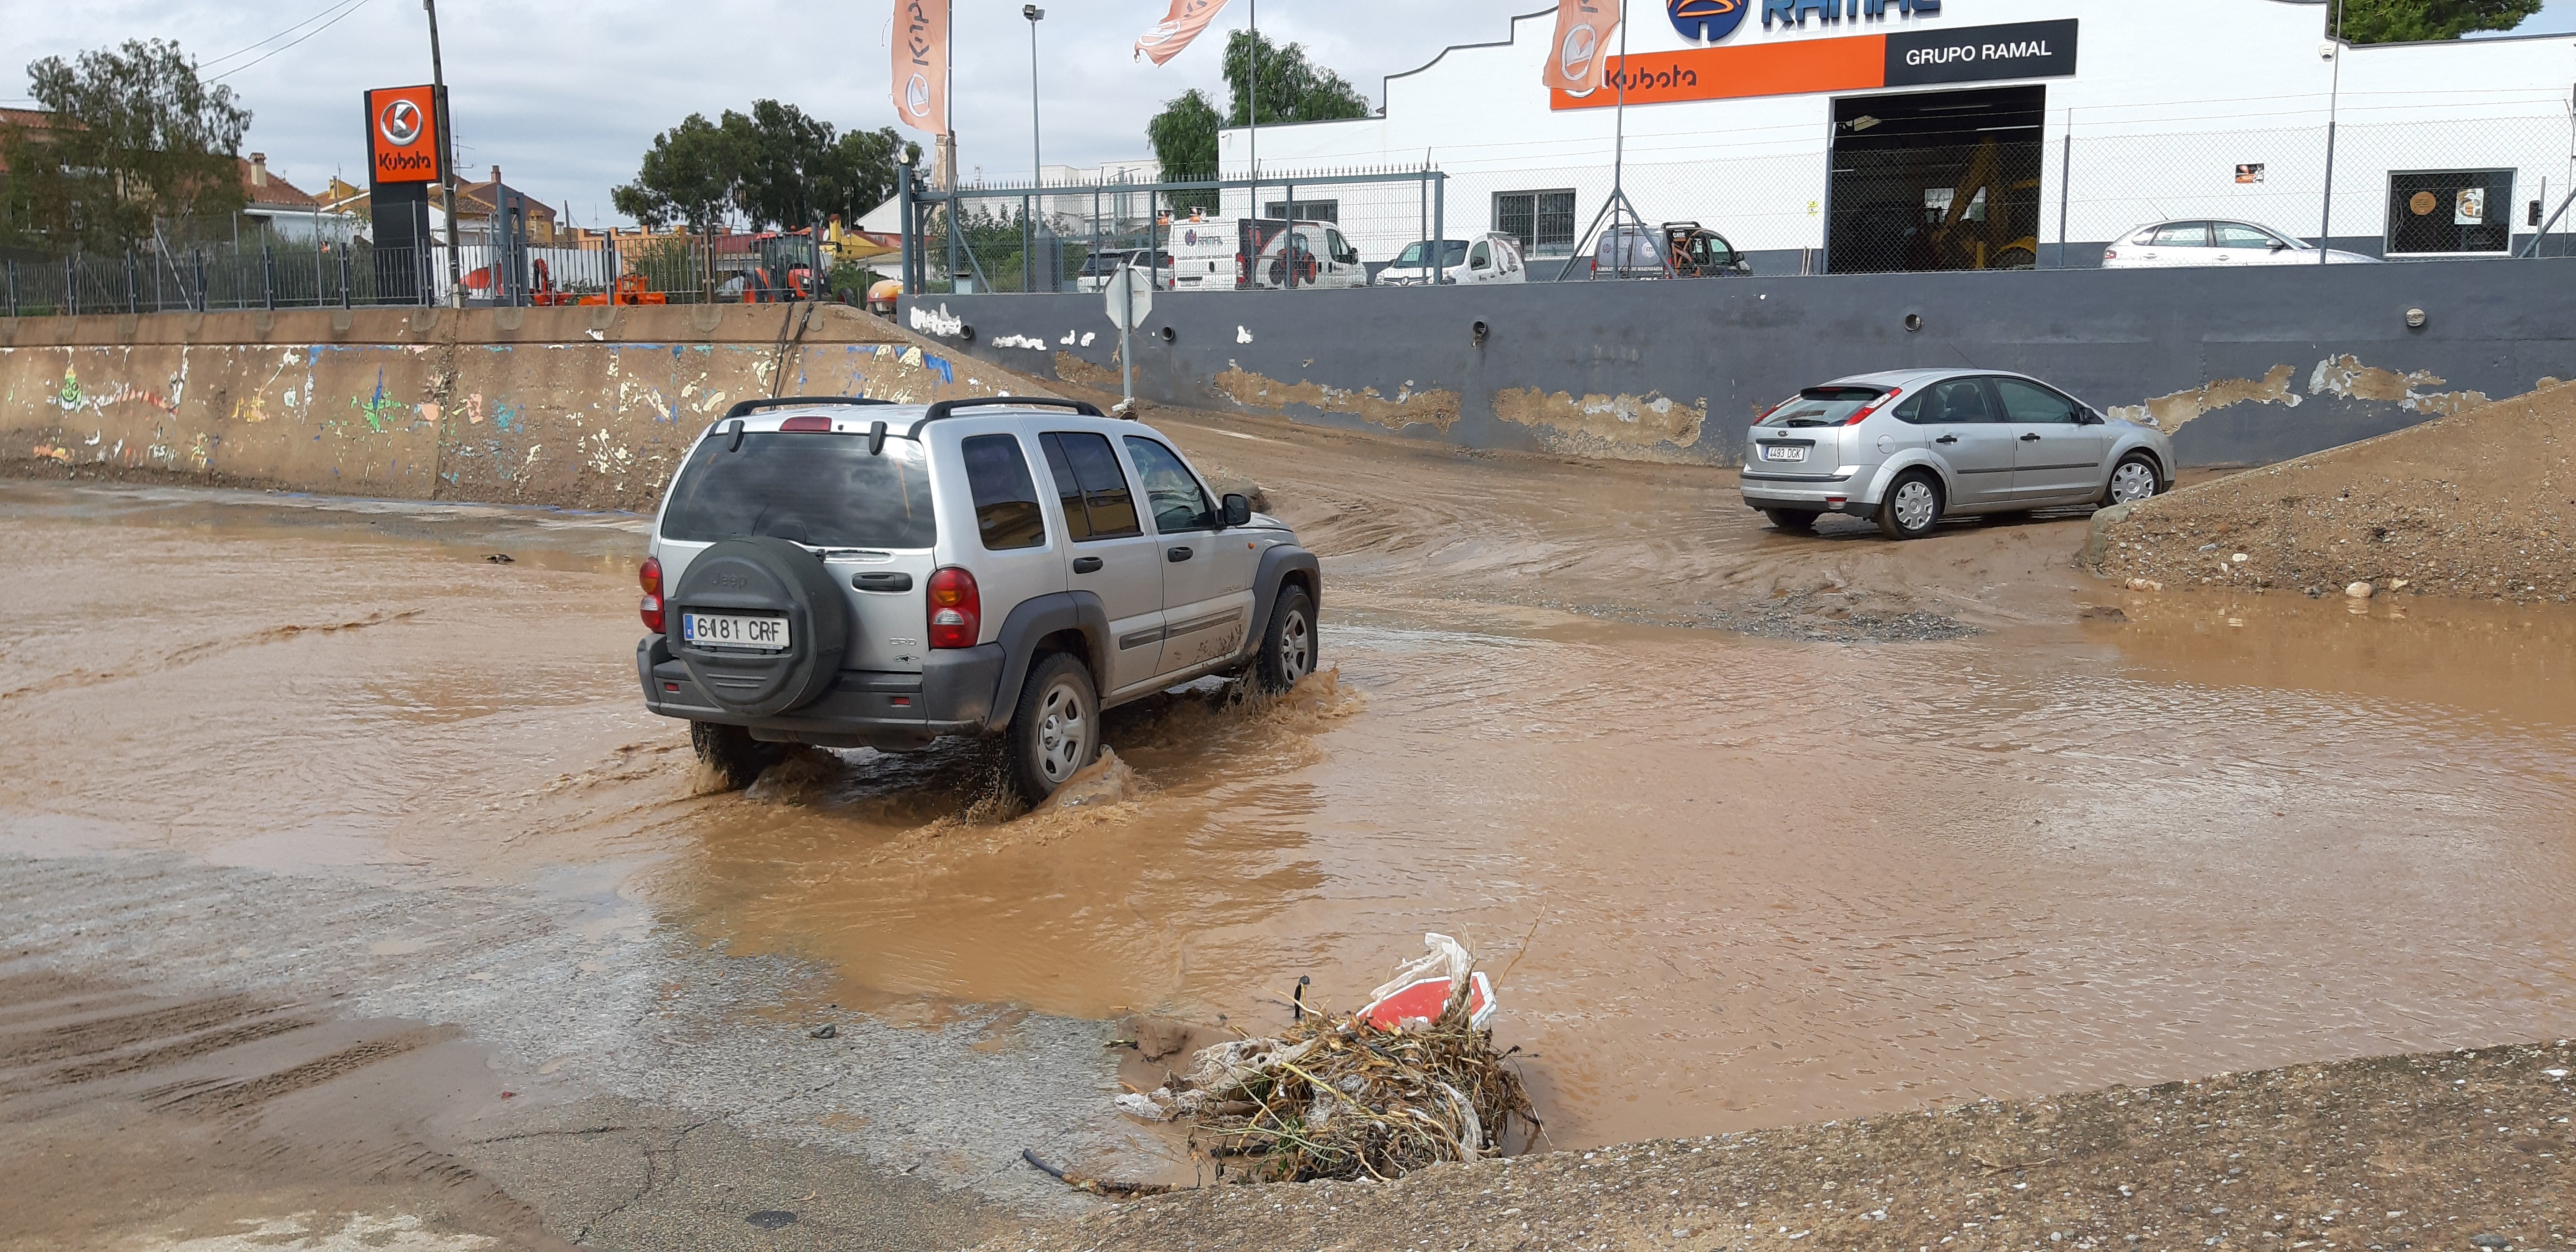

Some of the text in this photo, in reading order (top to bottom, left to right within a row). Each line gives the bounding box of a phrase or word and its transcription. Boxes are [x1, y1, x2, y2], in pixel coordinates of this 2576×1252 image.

[1906, 40, 2053, 65] GRUPO RAMAL
[379, 151, 431, 171] Kubota
[1770, 448, 1785, 458] 4493
[1786, 448, 1801, 459] DGK
[712, 571, 747, 590] Jeep
[697, 618, 781, 641] 6181 CRF
[890, 637, 917, 646] CRD
